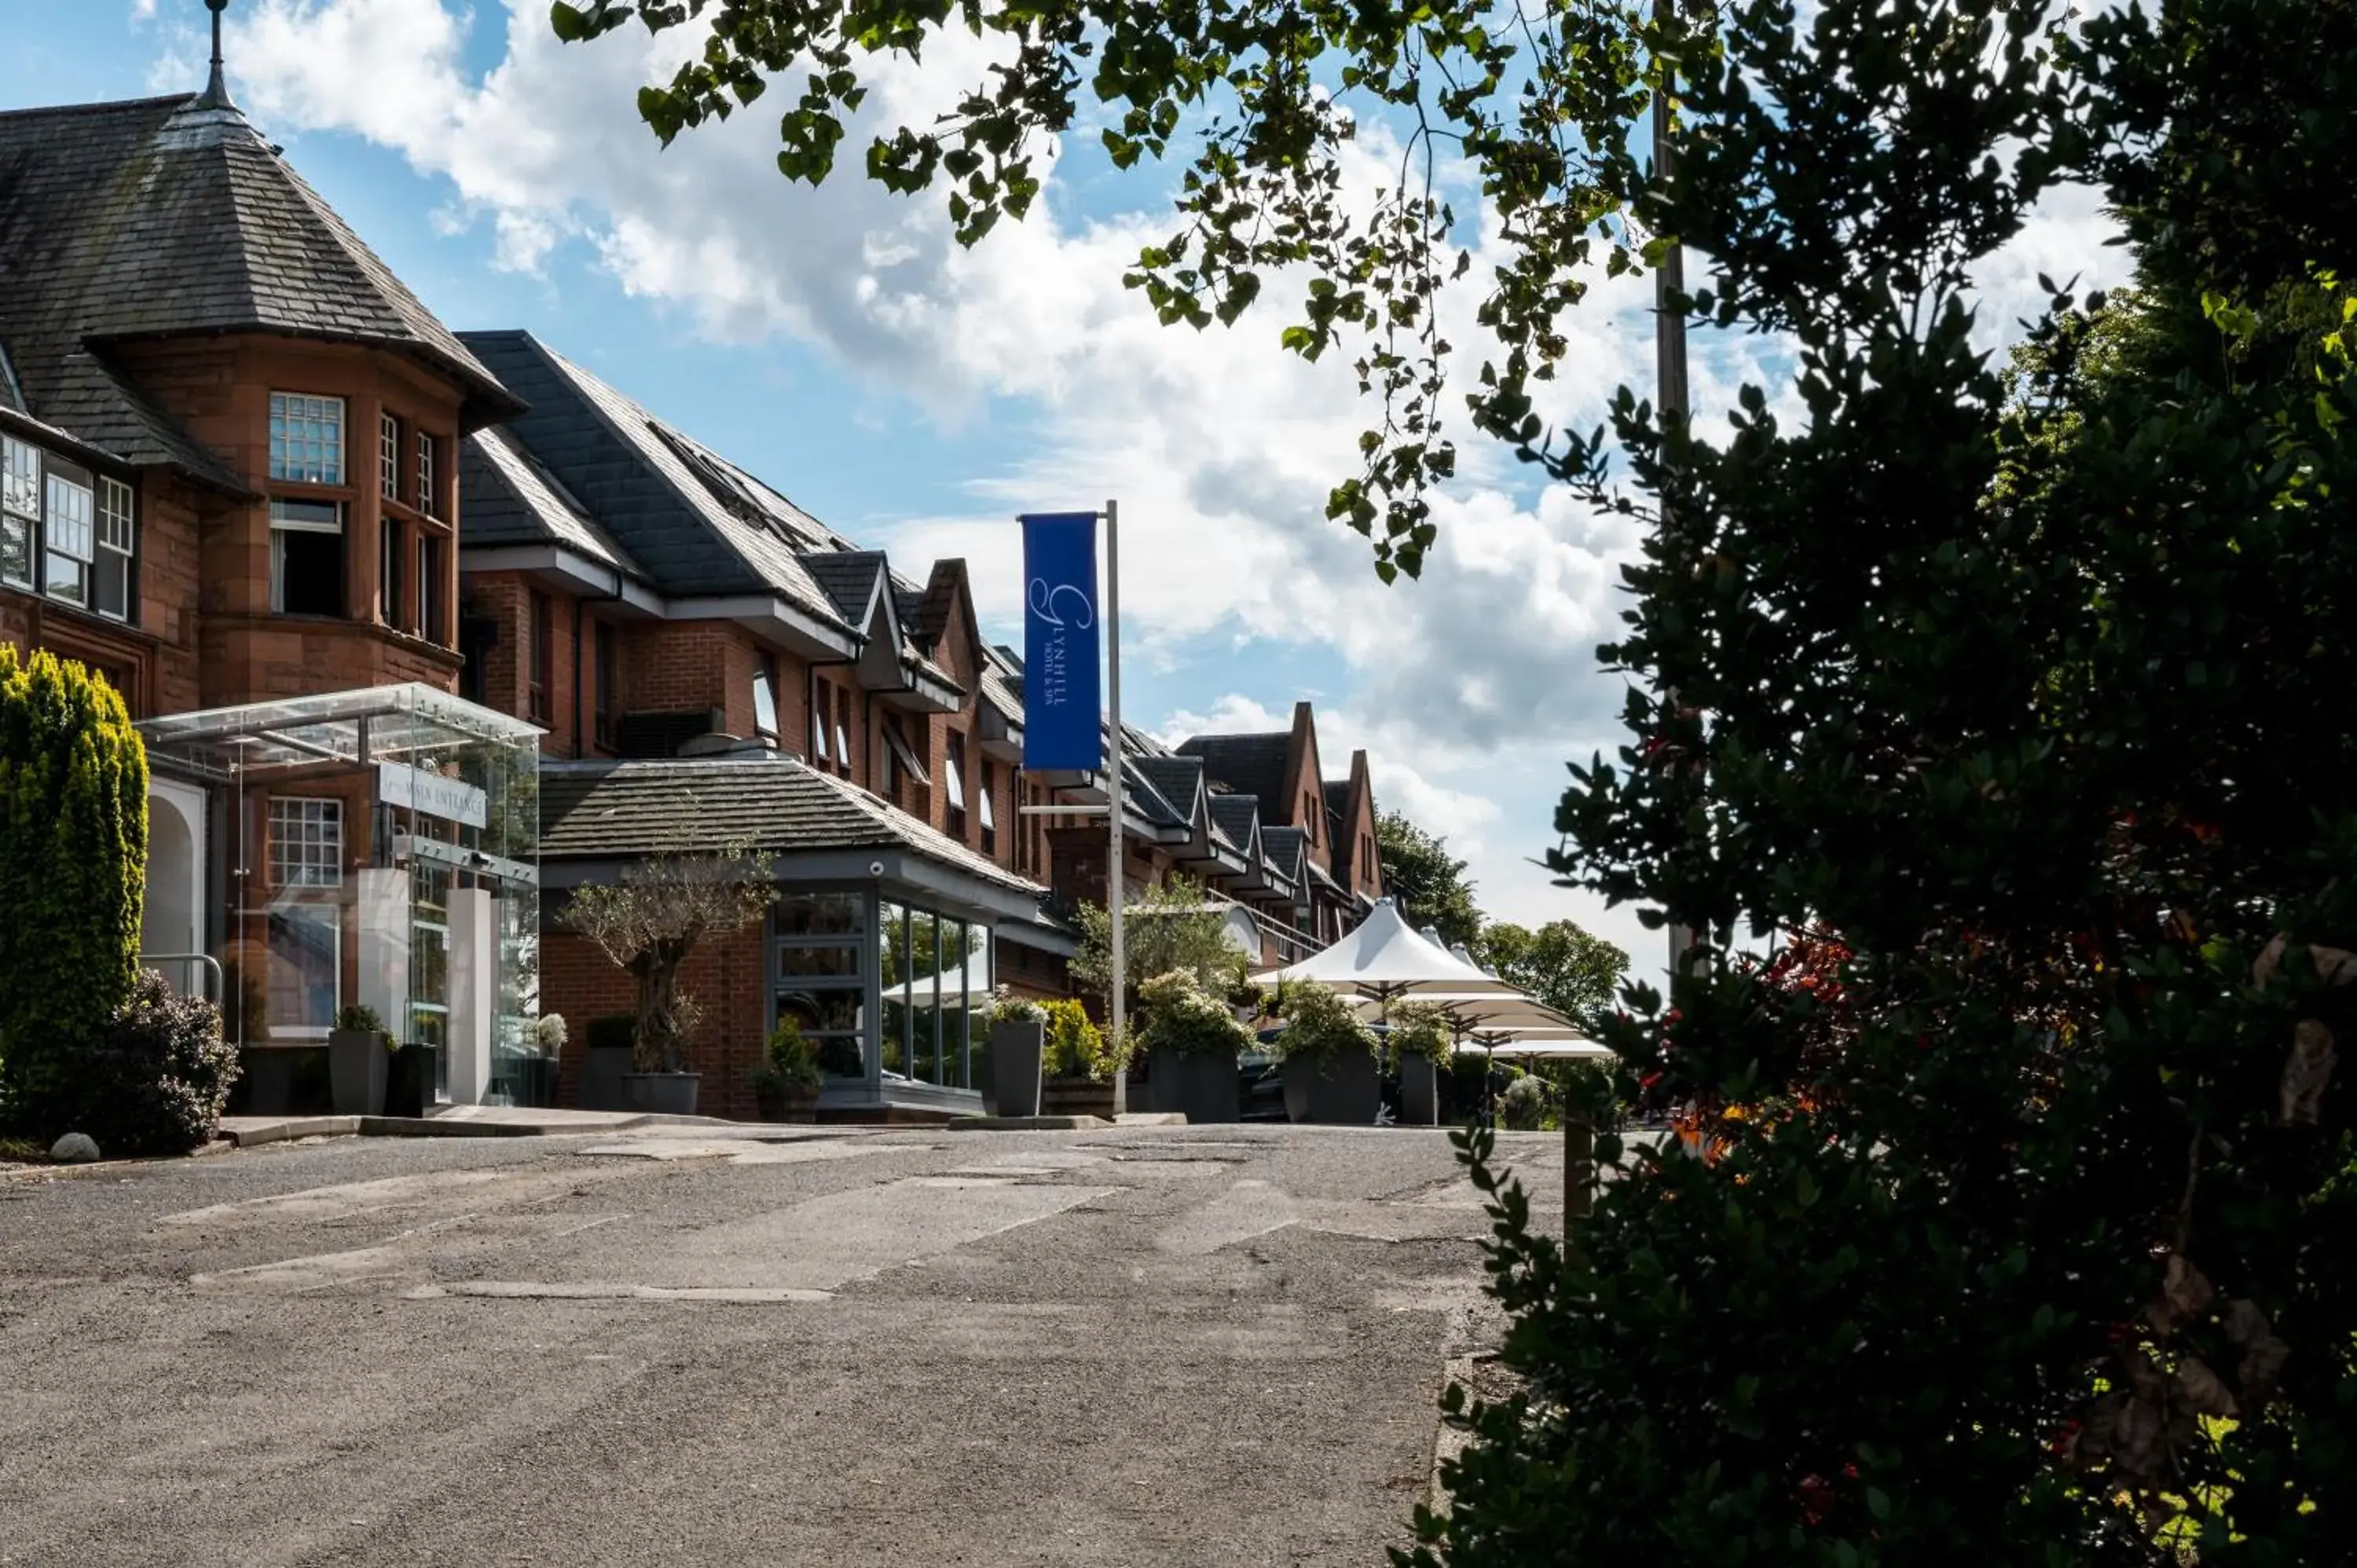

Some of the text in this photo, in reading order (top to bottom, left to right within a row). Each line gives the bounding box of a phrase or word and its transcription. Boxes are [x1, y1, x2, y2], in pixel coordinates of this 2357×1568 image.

[1028, 577, 1093, 705] GLYNHILL
[1044, 642, 1054, 705] HOTEL & SPA
[435, 789, 483, 815] ENTRANCE
